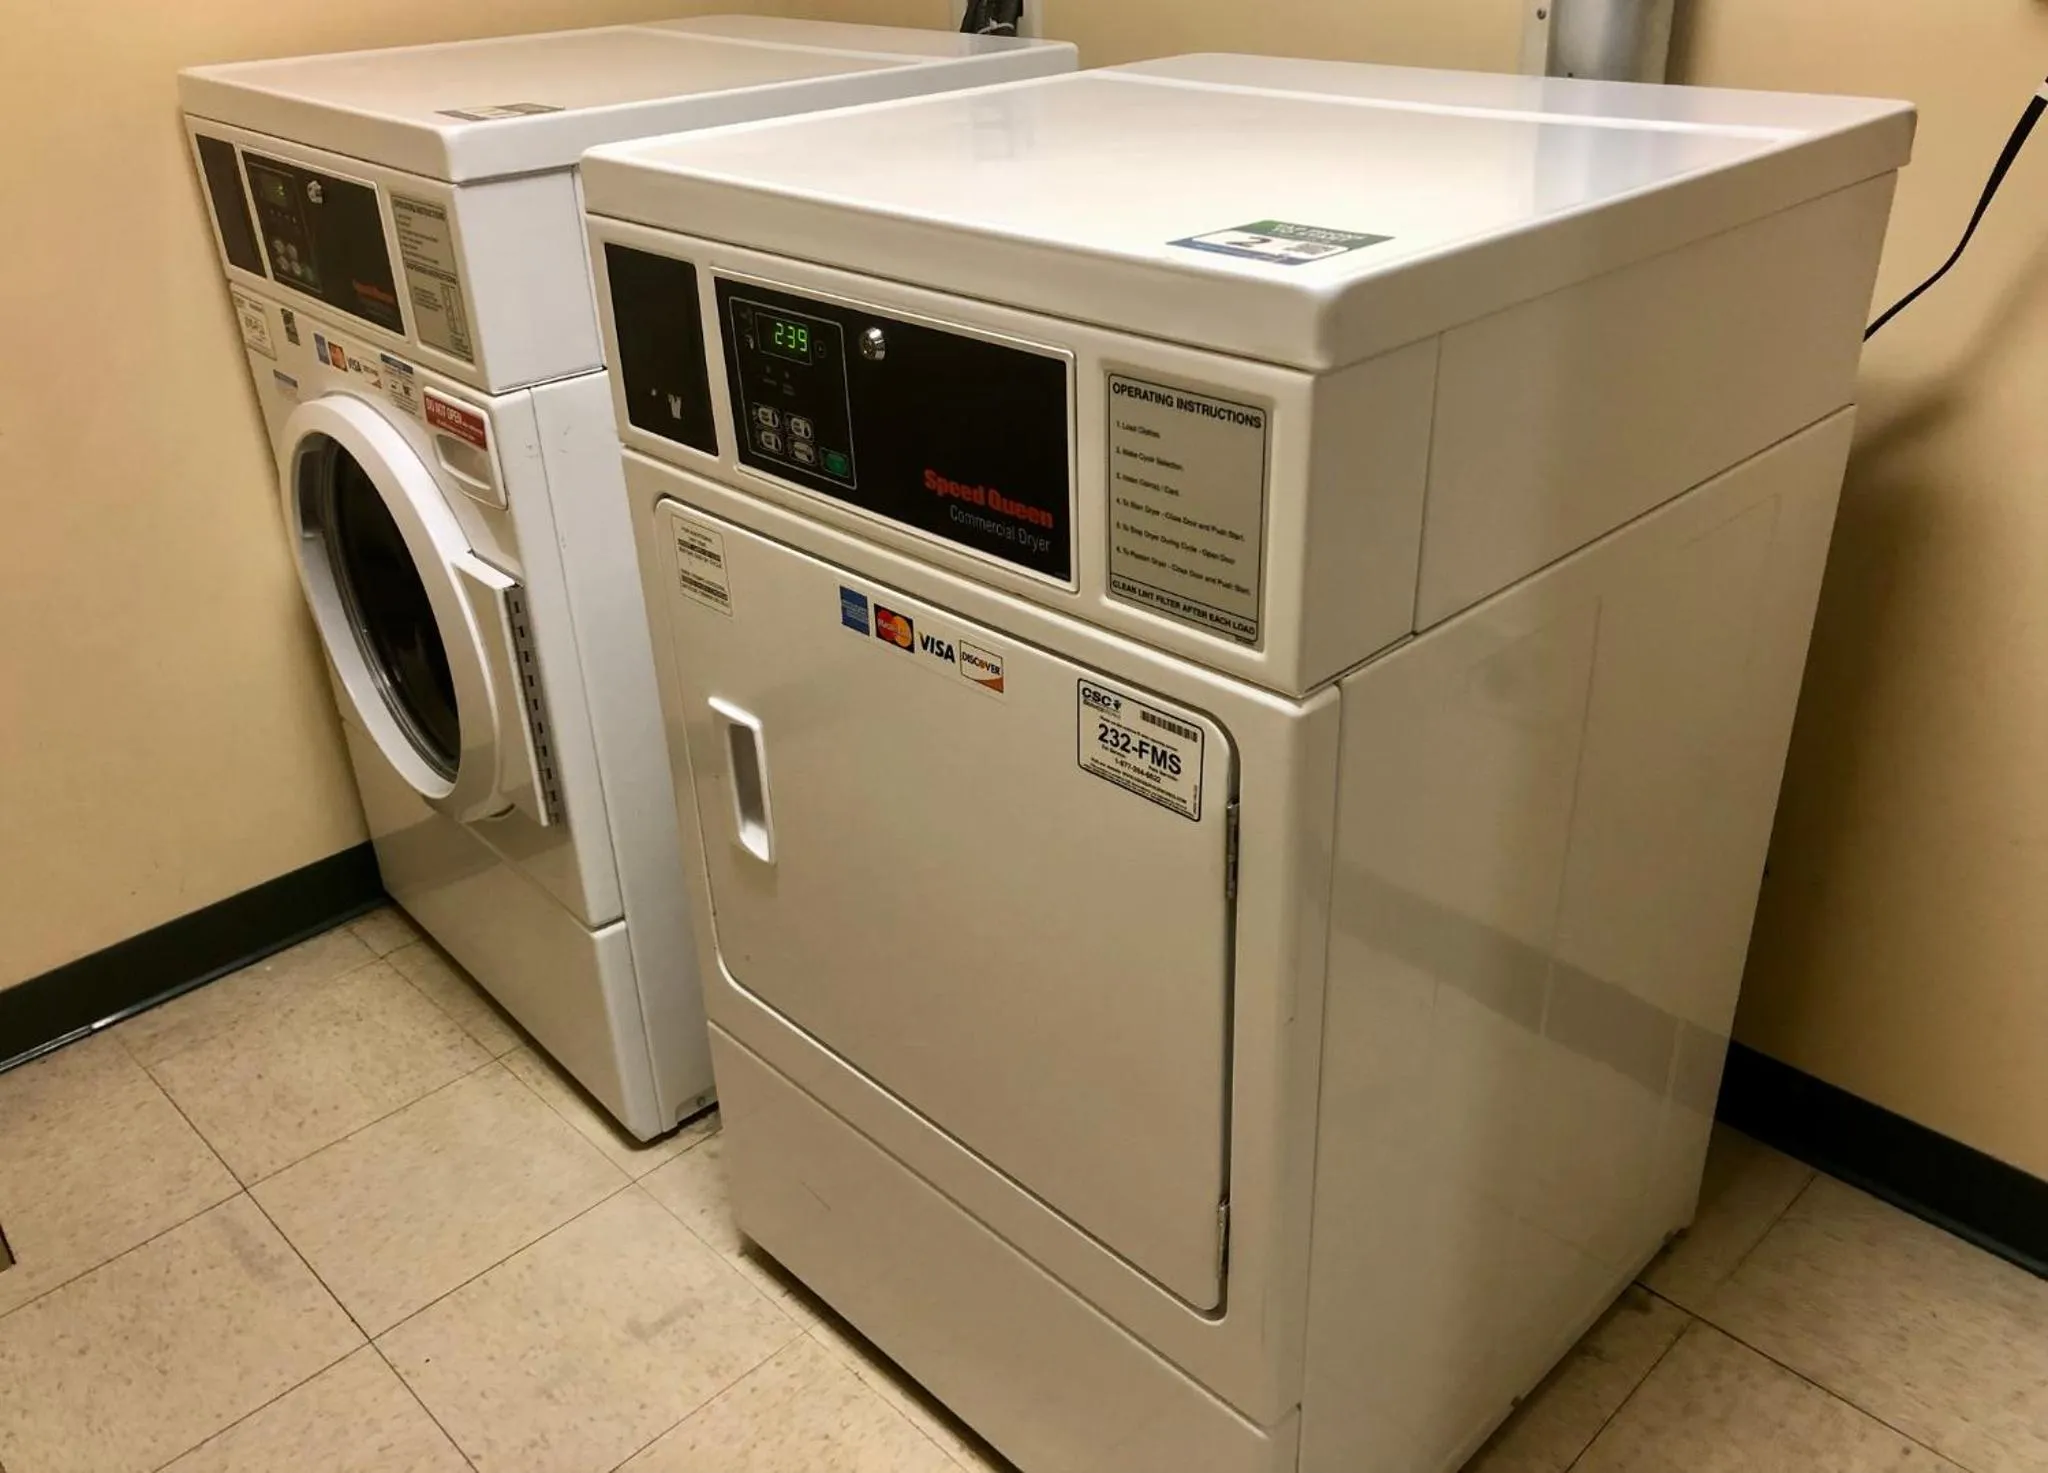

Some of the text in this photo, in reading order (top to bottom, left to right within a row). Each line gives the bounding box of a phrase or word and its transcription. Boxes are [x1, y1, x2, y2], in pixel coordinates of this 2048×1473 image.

[1225, 235, 1273, 248] 2
[775, 322, 808, 352] 239
[1112, 381, 1262, 429] OPERATING INSTRUCTIONS
[924, 468, 1054, 530] Speed Queen
[949, 503, 1051, 553] Commercial Dryer
[1112, 580, 1256, 636] CLEAN LINT FILTER AFTER EACH LOAD
[918, 631, 956, 664] VISA
[962, 651, 1001, 676] DISCOVER
[1081, 687, 1112, 707] CSC
[1098, 723, 1182, 775] 232-FMS
